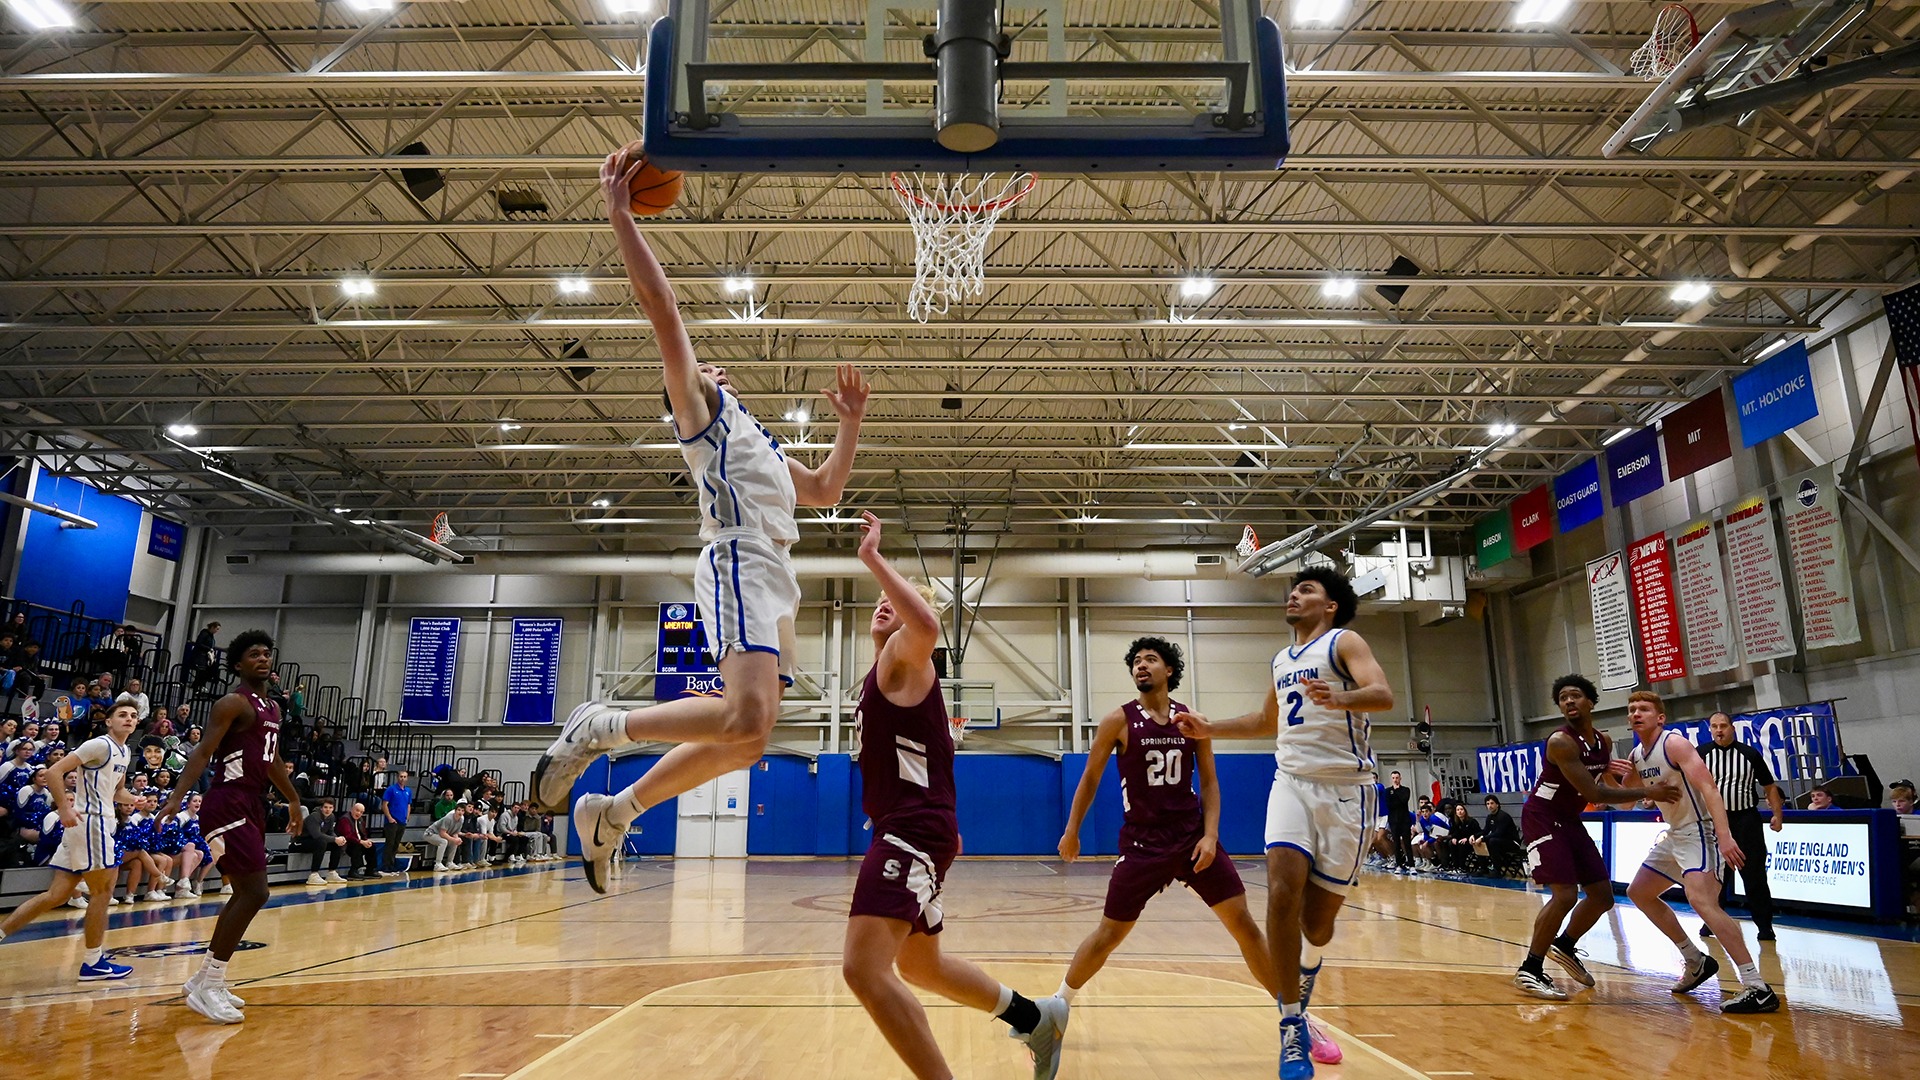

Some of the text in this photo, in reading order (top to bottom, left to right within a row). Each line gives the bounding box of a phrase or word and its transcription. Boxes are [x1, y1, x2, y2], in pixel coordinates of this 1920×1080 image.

[1742, 375, 1806, 416] MT. HOLYOKE
[1688, 428, 1700, 444] MIT
[1617, 455, 1651, 478] EMERSON
[1556, 482, 1598, 510] COAST GUARD
[1522, 512, 1540, 528] CLARK
[1727, 502, 1763, 525] NEWMAC
[1483, 532, 1502, 548] BABSON
[664, 621, 693, 630] WHEATON
[1276, 668, 1318, 690] WHEATON
[1287, 690, 1304, 726] 2
[1140, 737, 1186, 746] SPRINGFIELD
[1145, 749, 1182, 786] 20
[1776, 842, 1848, 858] NEW ENGLAND
[883, 860, 902, 880] S
[1774, 858, 1820, 873] WOMEN'S
[1823, 860, 1829, 873] &
[1831, 860, 1865, 876] MEN'S
[1774, 873, 1836, 886] ATHLETIC CONFERENCE
